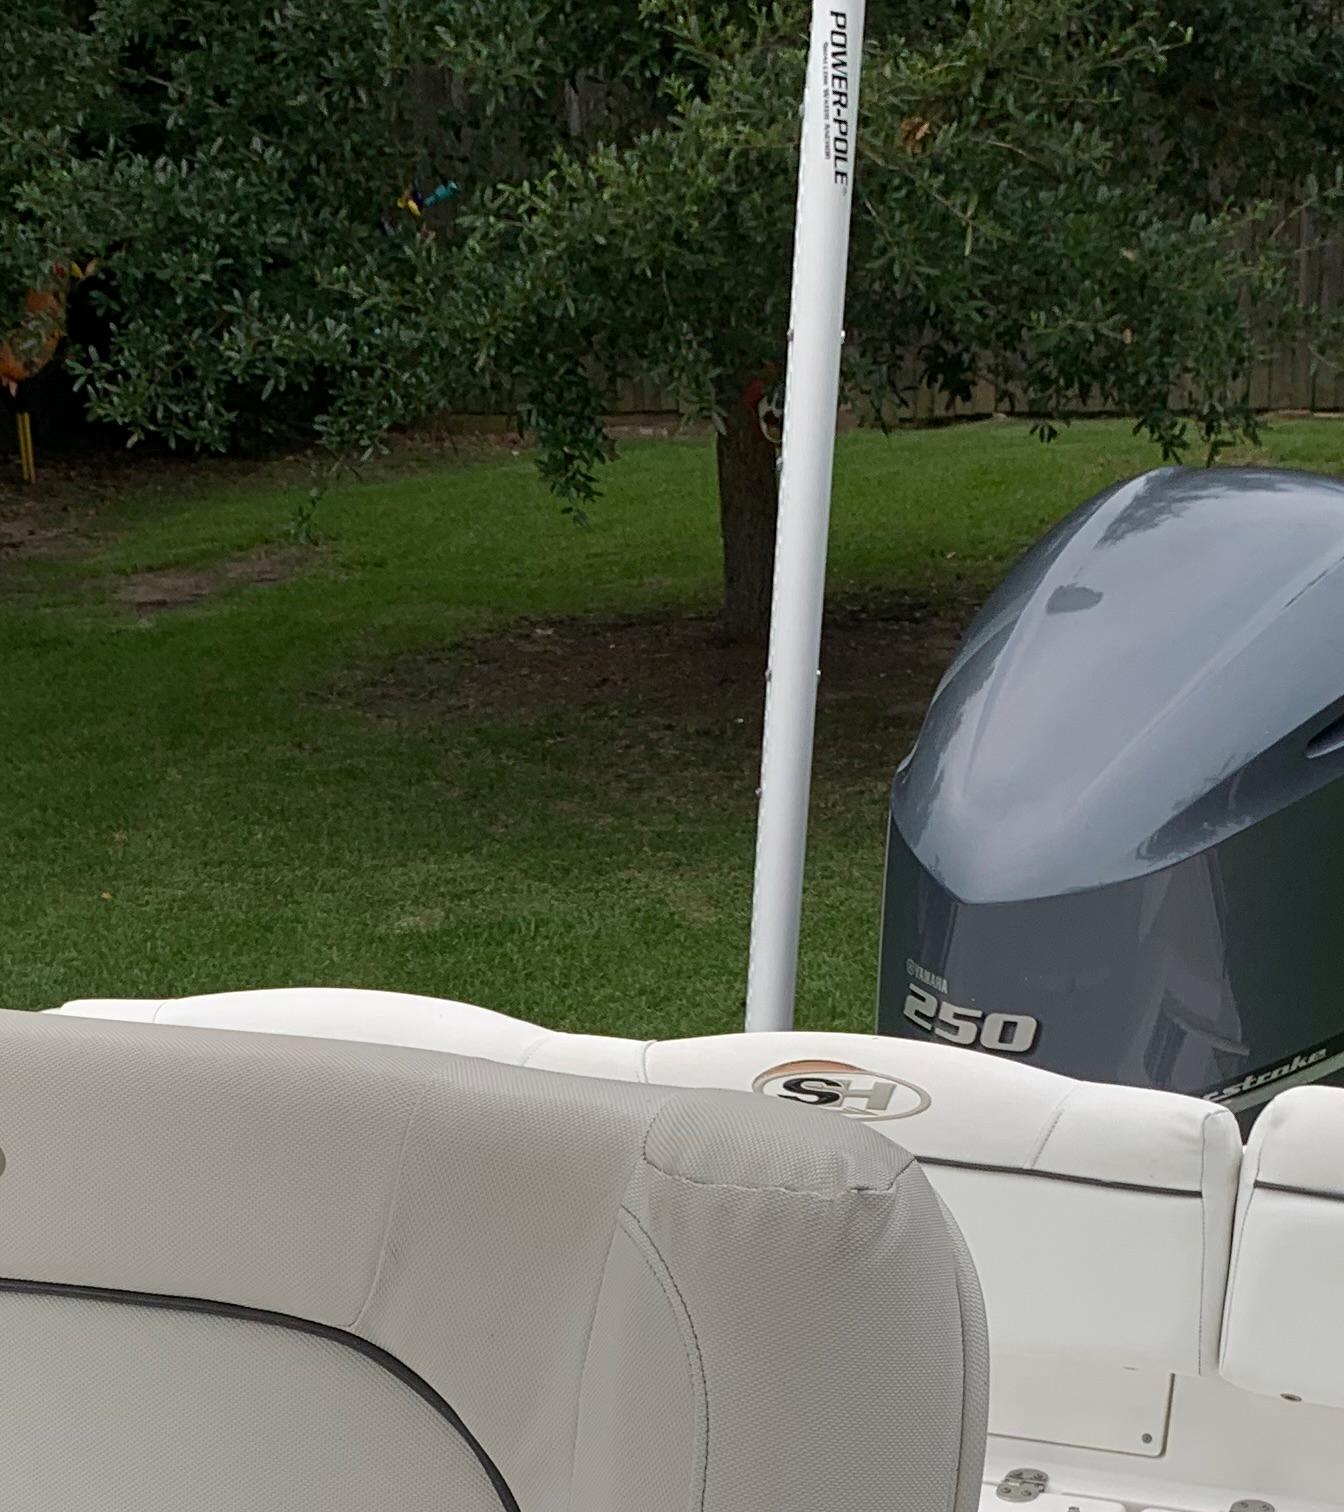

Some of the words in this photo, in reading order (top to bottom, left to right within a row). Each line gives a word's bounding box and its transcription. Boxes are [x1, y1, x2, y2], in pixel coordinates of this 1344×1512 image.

[830, 11, 849, 186] POWER-POLE
[912, 962, 949, 994] YAMAHA
[903, 982, 1038, 1053] 250
